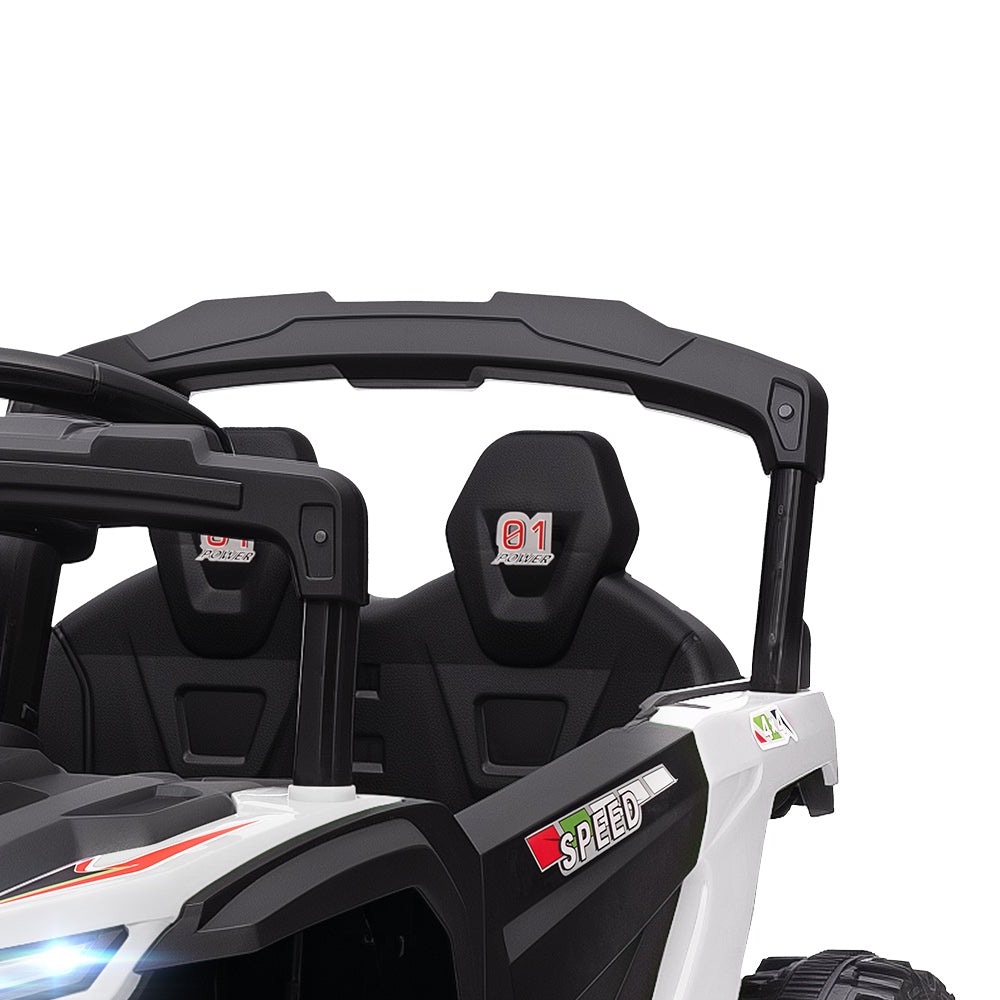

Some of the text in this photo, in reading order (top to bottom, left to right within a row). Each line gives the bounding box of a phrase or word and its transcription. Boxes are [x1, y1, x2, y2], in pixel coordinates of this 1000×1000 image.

[502, 519, 546, 551] 01
[199, 549, 254, 561] POWER
[496, 553, 553, 564] POWER
[558, 789, 640, 872] SPEED
